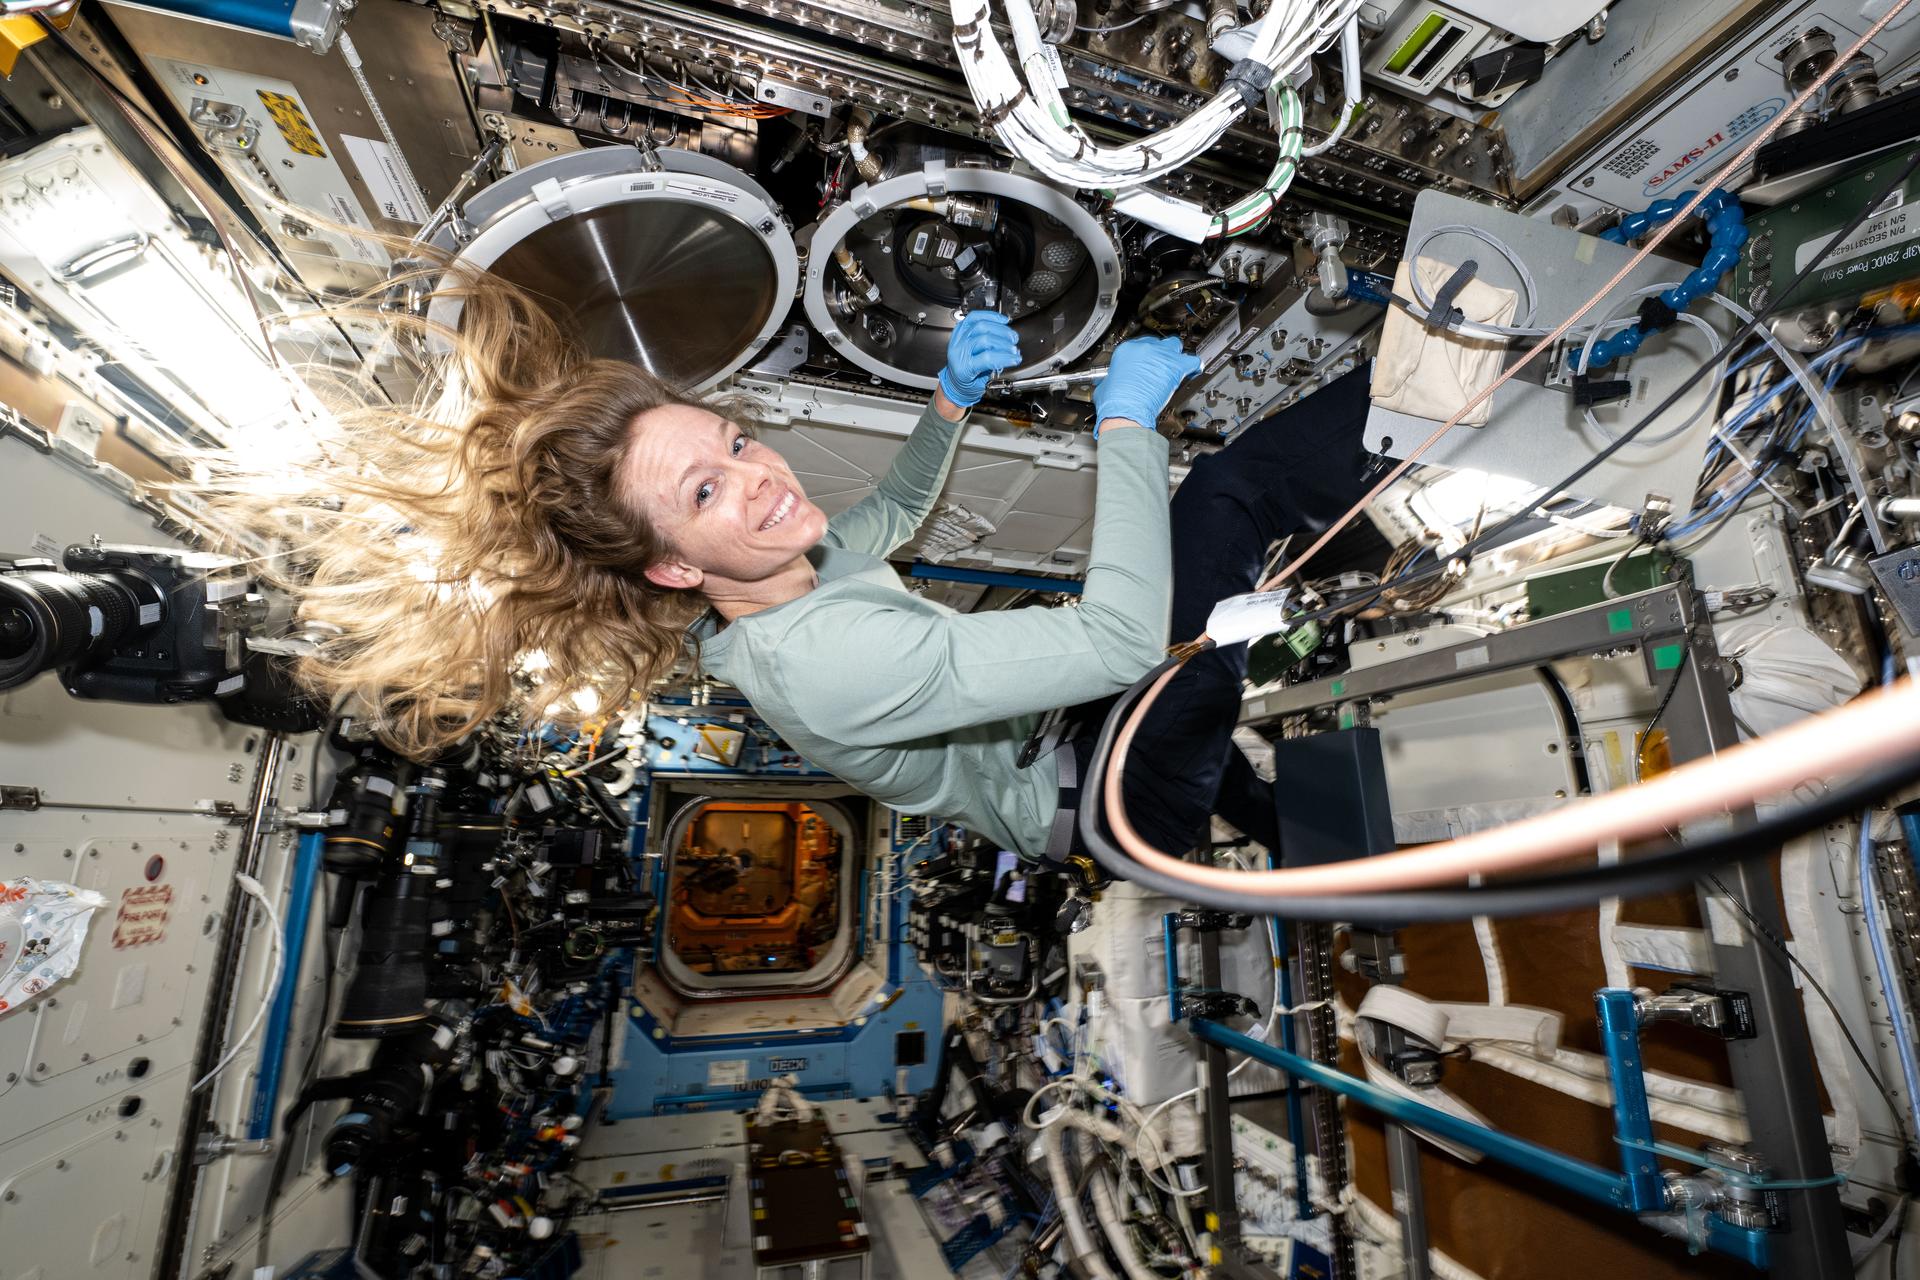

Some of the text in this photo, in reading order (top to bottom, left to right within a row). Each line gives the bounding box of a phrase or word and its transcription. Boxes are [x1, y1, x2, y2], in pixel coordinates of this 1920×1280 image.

[1769, 25, 1799, 47] SENSORS
[1613, 46, 1635, 69] FRONT
[1602, 139, 1644, 170] REMOTE
[1608, 140, 1654, 172] TRIAXIAL
[1614, 144, 1656, 174] SENSOR
[1620, 147, 1661, 177] SYSTEM
[1648, 133, 1724, 187] SAMS-II
[384, 201, 400, 219] MSL
[1867, 213, 1906, 234] S/N 1347
[1890, 225, 1906, 238] P/N
[1846, 261, 1869, 275] Power
[1871, 250, 1900, 269] 28VDC
[1821, 268, 1844, 284] Supply
[770, 1060, 805, 1072] DECK
